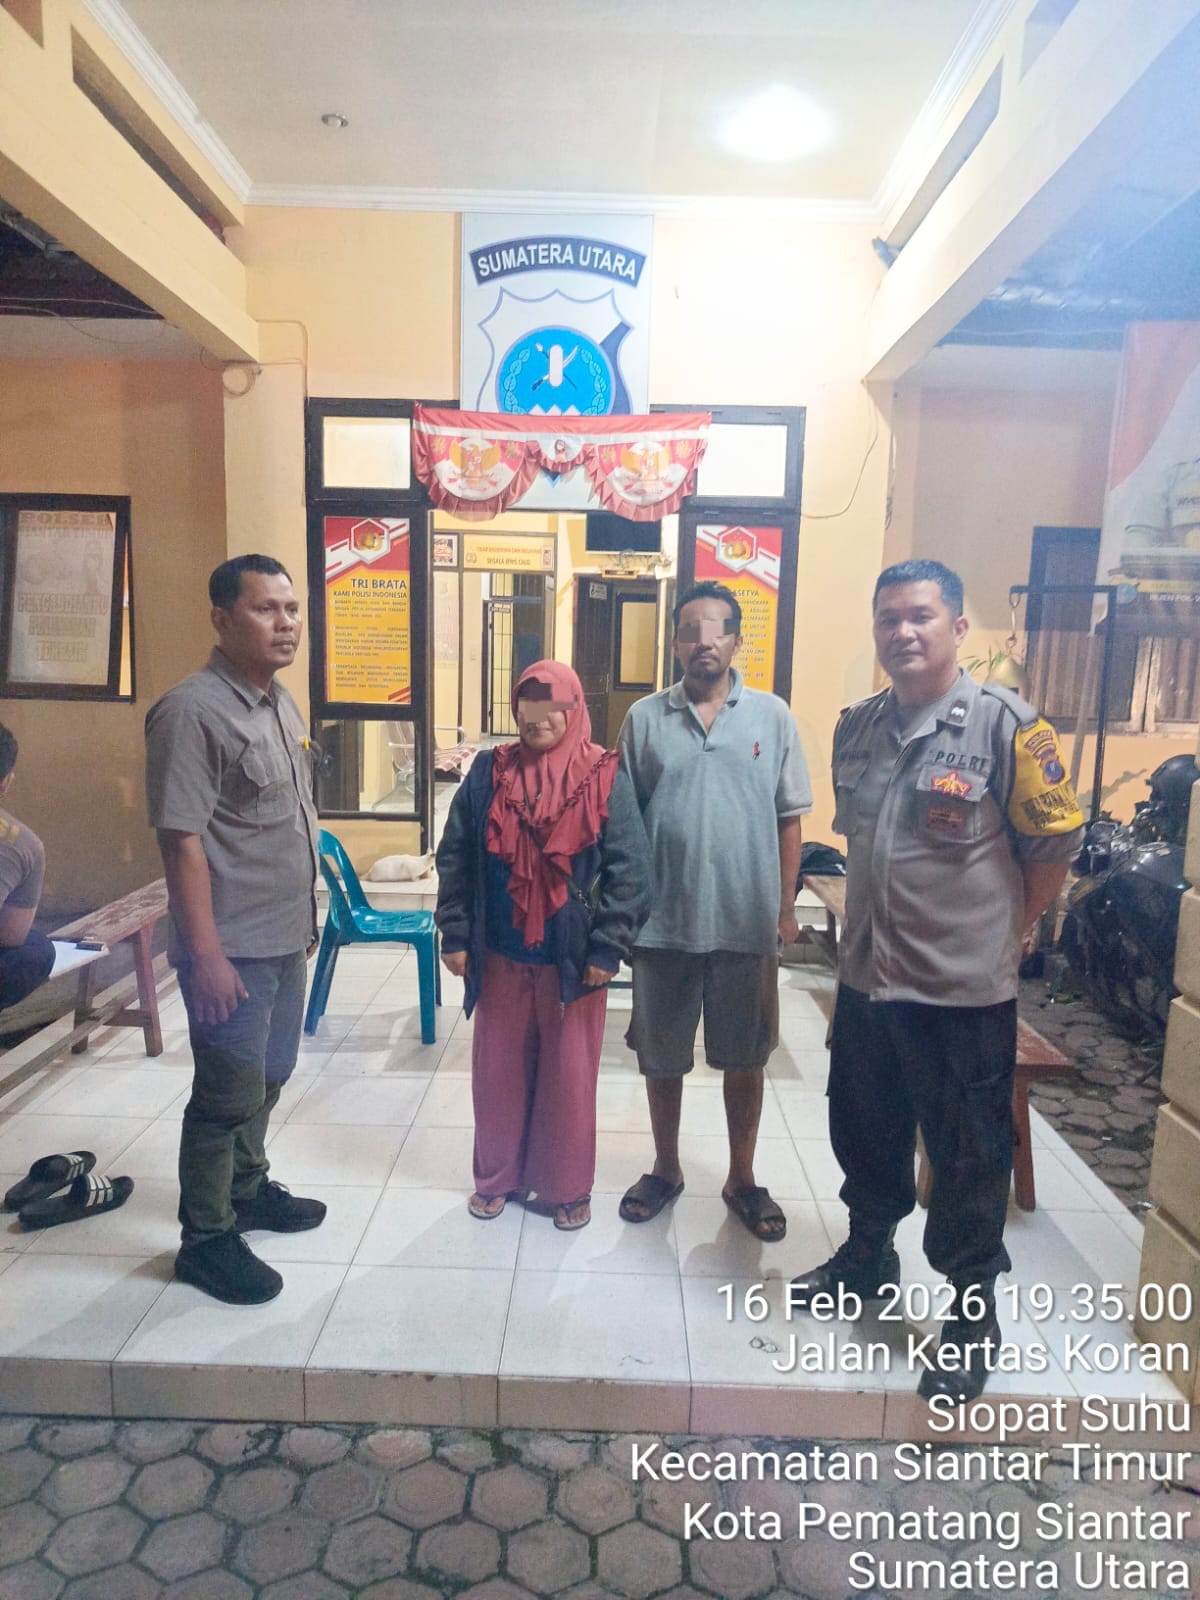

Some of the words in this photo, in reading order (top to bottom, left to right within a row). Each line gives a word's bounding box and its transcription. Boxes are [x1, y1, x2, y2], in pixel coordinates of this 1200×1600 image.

[477, 243, 574, 277] SUMATERA
[579, 244, 636, 280] UTARA
[351, 578, 368, 588] TRI
[371, 579, 407, 589] BRATA
[372, 591, 407, 599] INDONESIA
